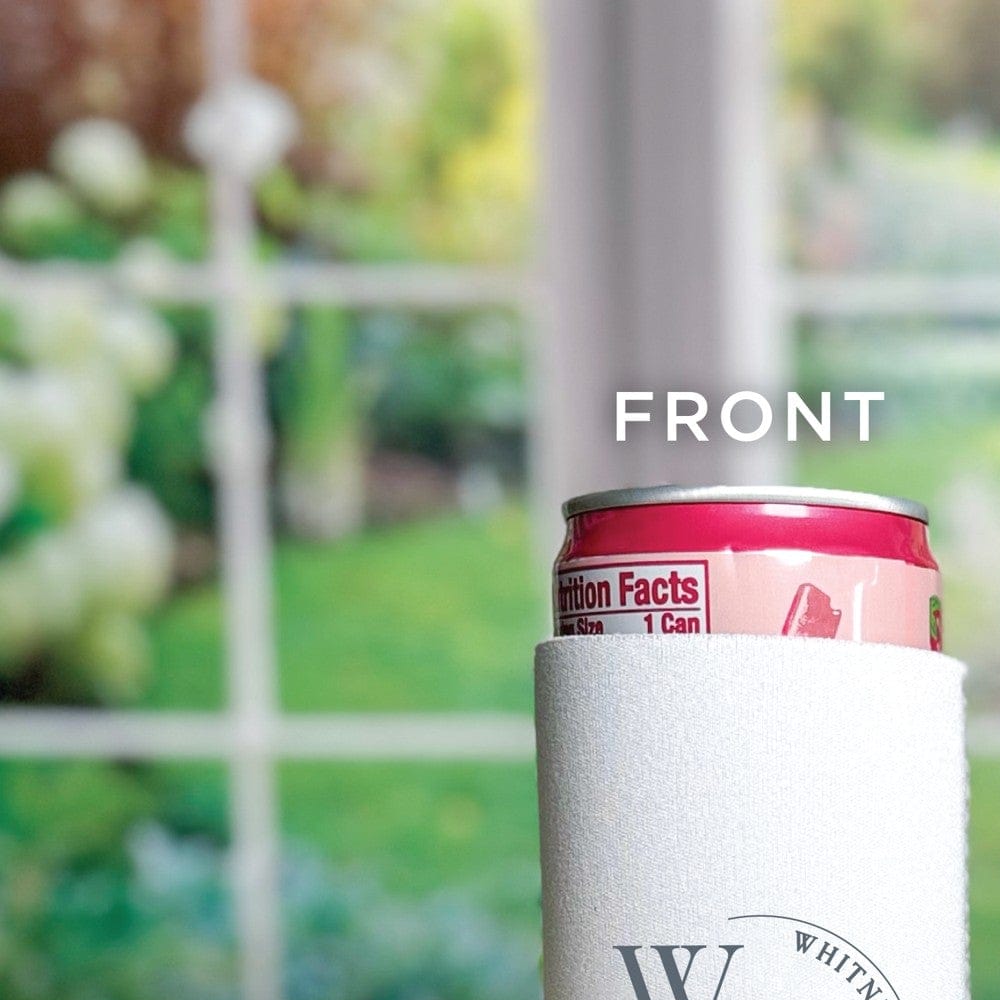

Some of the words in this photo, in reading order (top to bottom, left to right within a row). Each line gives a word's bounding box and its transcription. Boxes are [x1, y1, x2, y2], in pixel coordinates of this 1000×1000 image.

[619, 571, 699, 606] Facts
[644, 613, 654, 634] 1
[661, 612, 701, 634] Can
